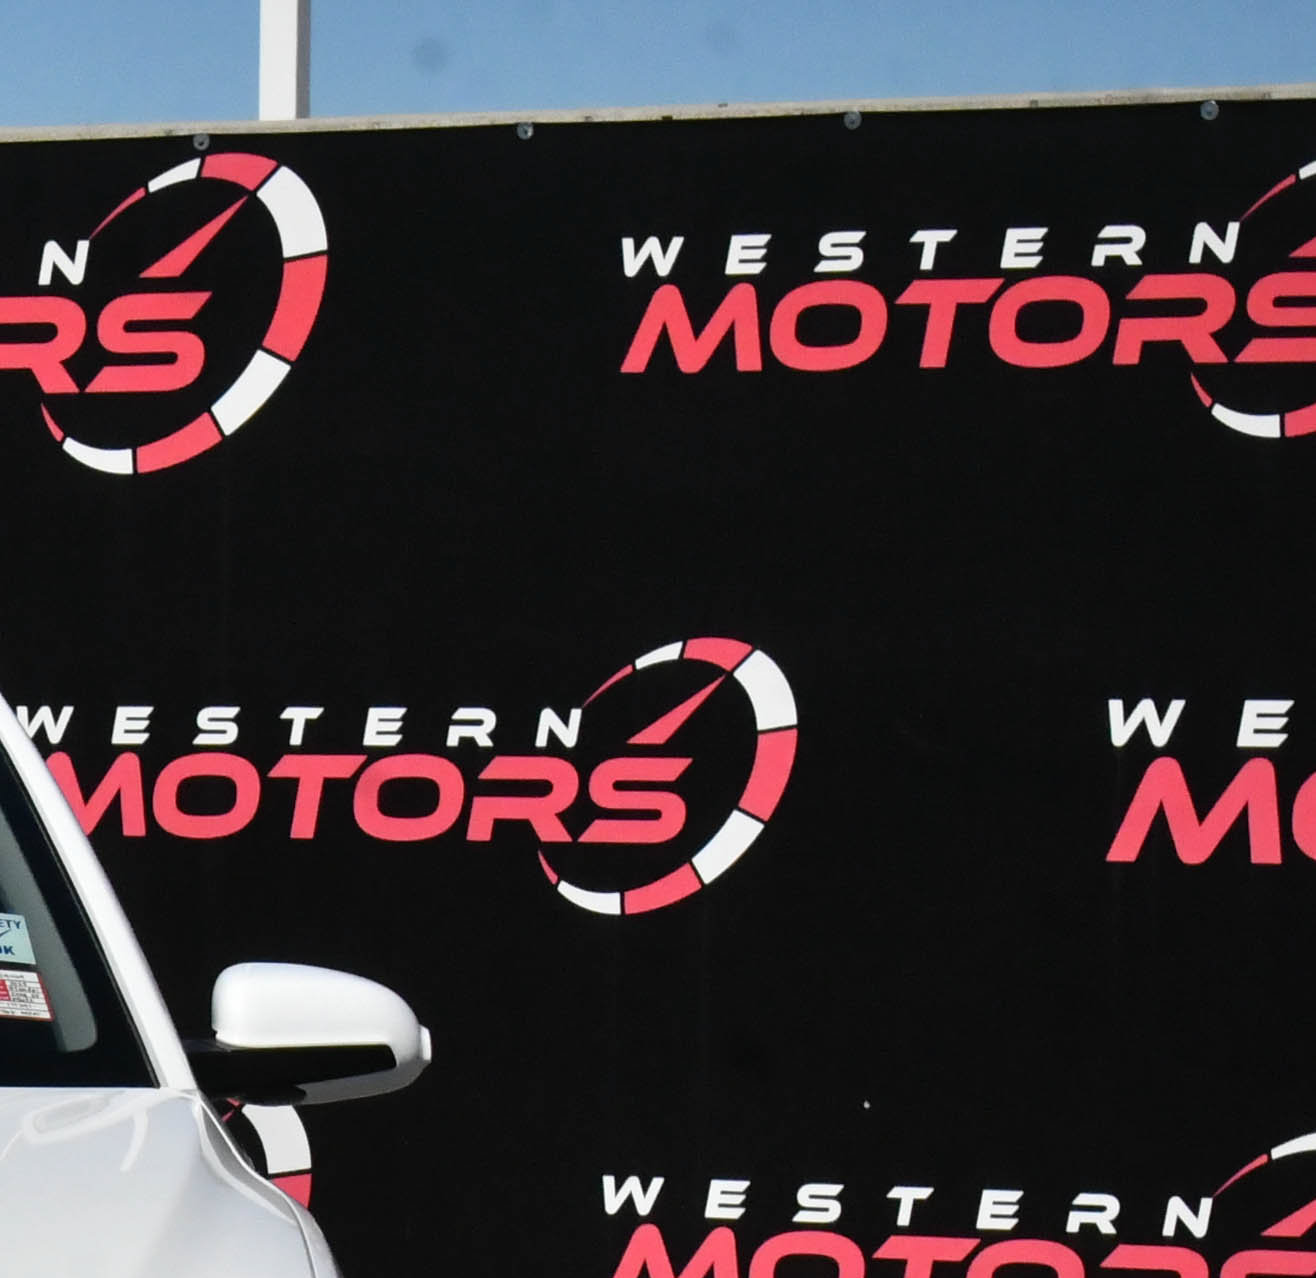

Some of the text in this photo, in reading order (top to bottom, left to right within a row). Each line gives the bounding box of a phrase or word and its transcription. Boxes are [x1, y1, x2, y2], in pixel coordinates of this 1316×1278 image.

[621, 221, 1240, 278] WESTERN
[16, 706, 582, 748] WESTERN
[602, 1175, 1213, 1239] WESTERN
